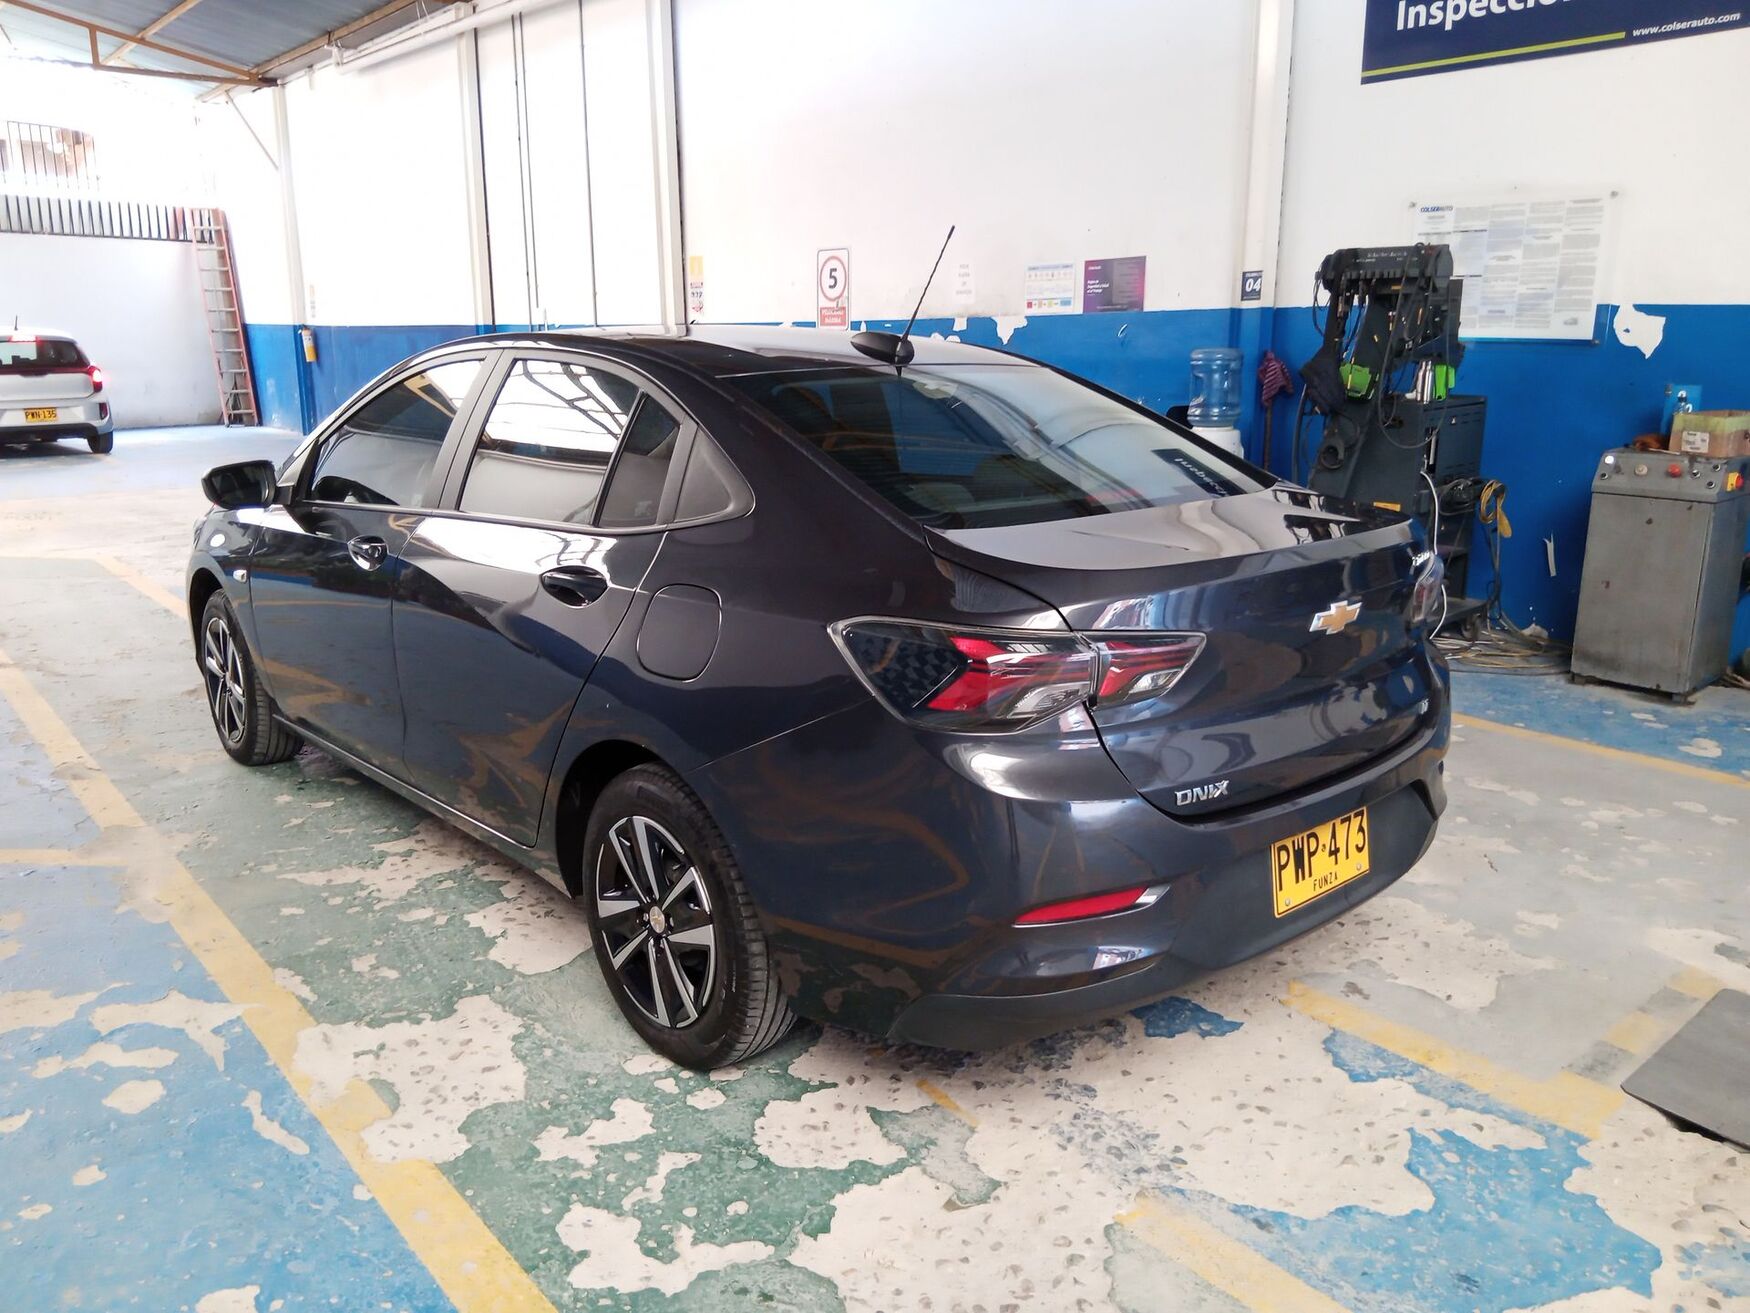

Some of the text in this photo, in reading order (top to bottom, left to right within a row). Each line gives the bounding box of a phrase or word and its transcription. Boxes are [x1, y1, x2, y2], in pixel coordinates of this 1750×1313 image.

[1396, 0, 1571, 31] Inspec
[1632, 12, 1741, 37] www.colserauto.com
[828, 267, 838, 289] 5
[1245, 278, 1262, 292] 04
[1174, 779, 1230, 806] ONIX
[1313, 871, 1338, 892] FUNZA
